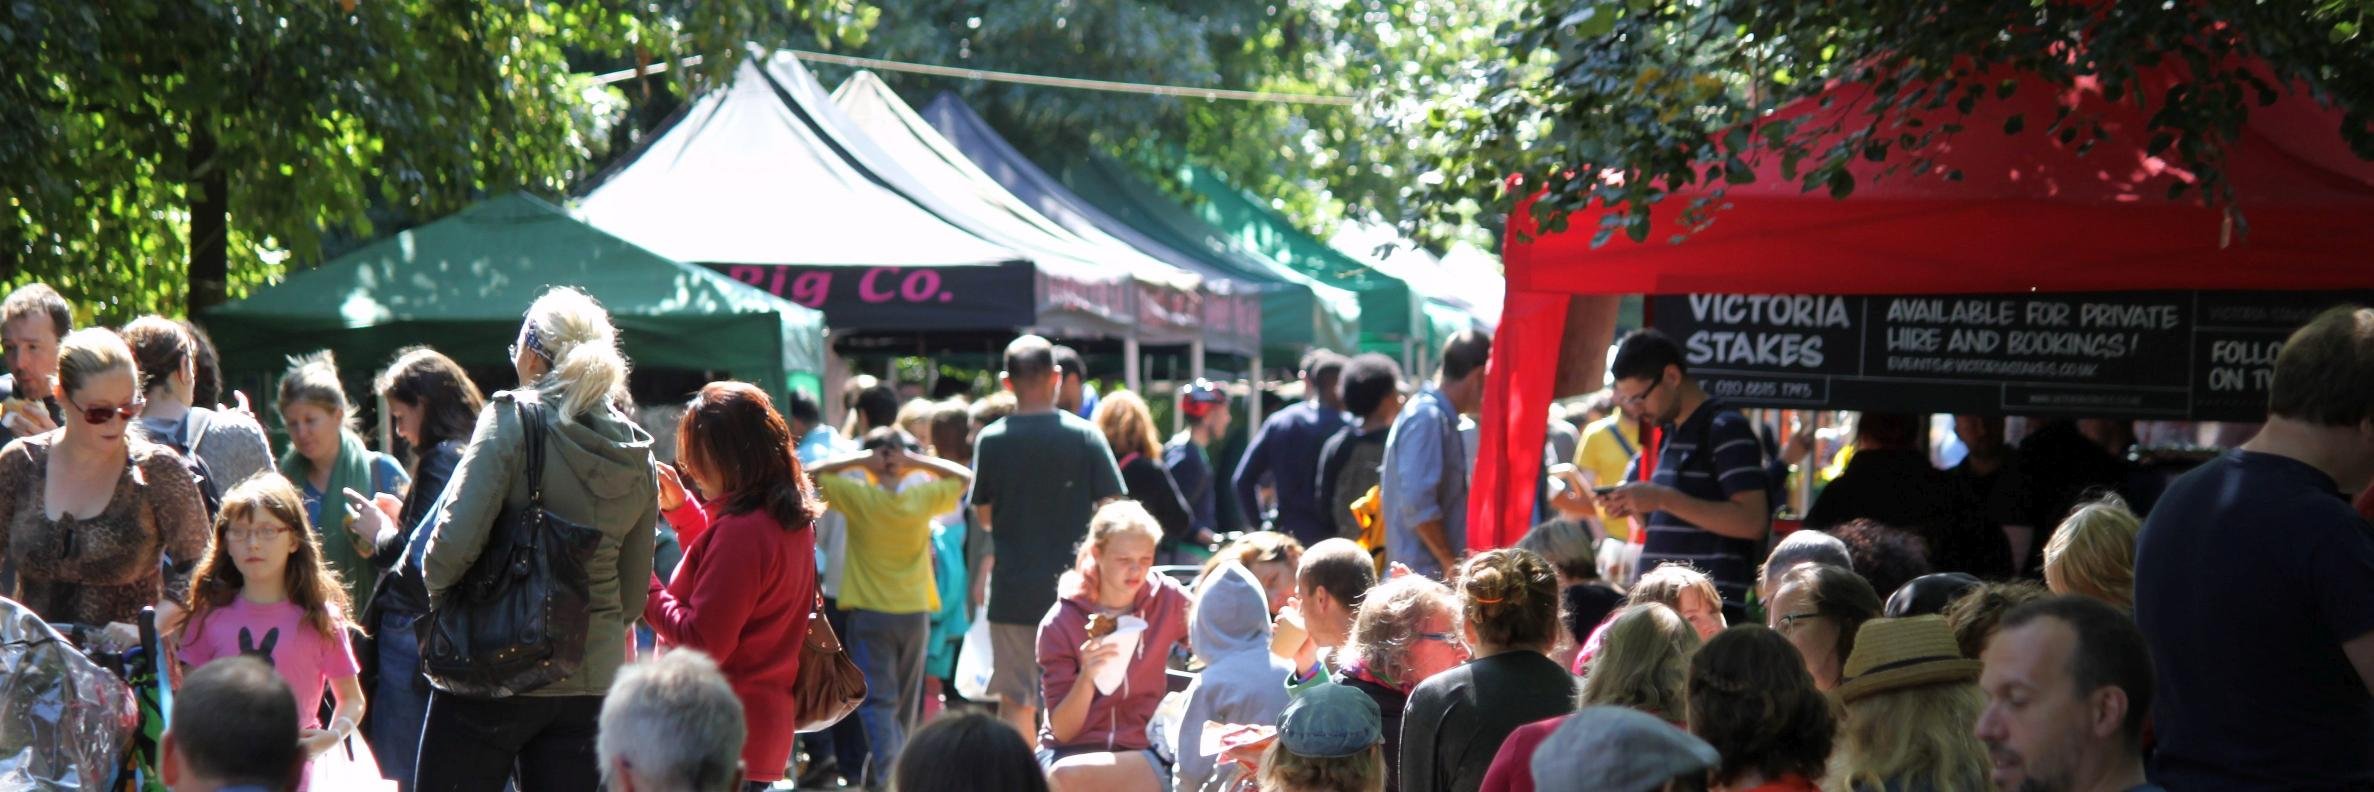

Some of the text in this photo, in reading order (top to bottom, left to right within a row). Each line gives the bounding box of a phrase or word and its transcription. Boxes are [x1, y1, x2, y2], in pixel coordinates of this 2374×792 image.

[858, 267, 954, 303] Co.
[1688, 293, 1850, 328] VICTORIA
[1886, 298, 2179, 329] AVAILABLE FOR PRIVATE
[1686, 330, 1824, 367] STAKES
[1887, 326, 1942, 353] HIRE
[1947, 328, 2001, 353] AND
[2212, 340, 2283, 365] FOLLO
[2208, 367, 2246, 392] ON
